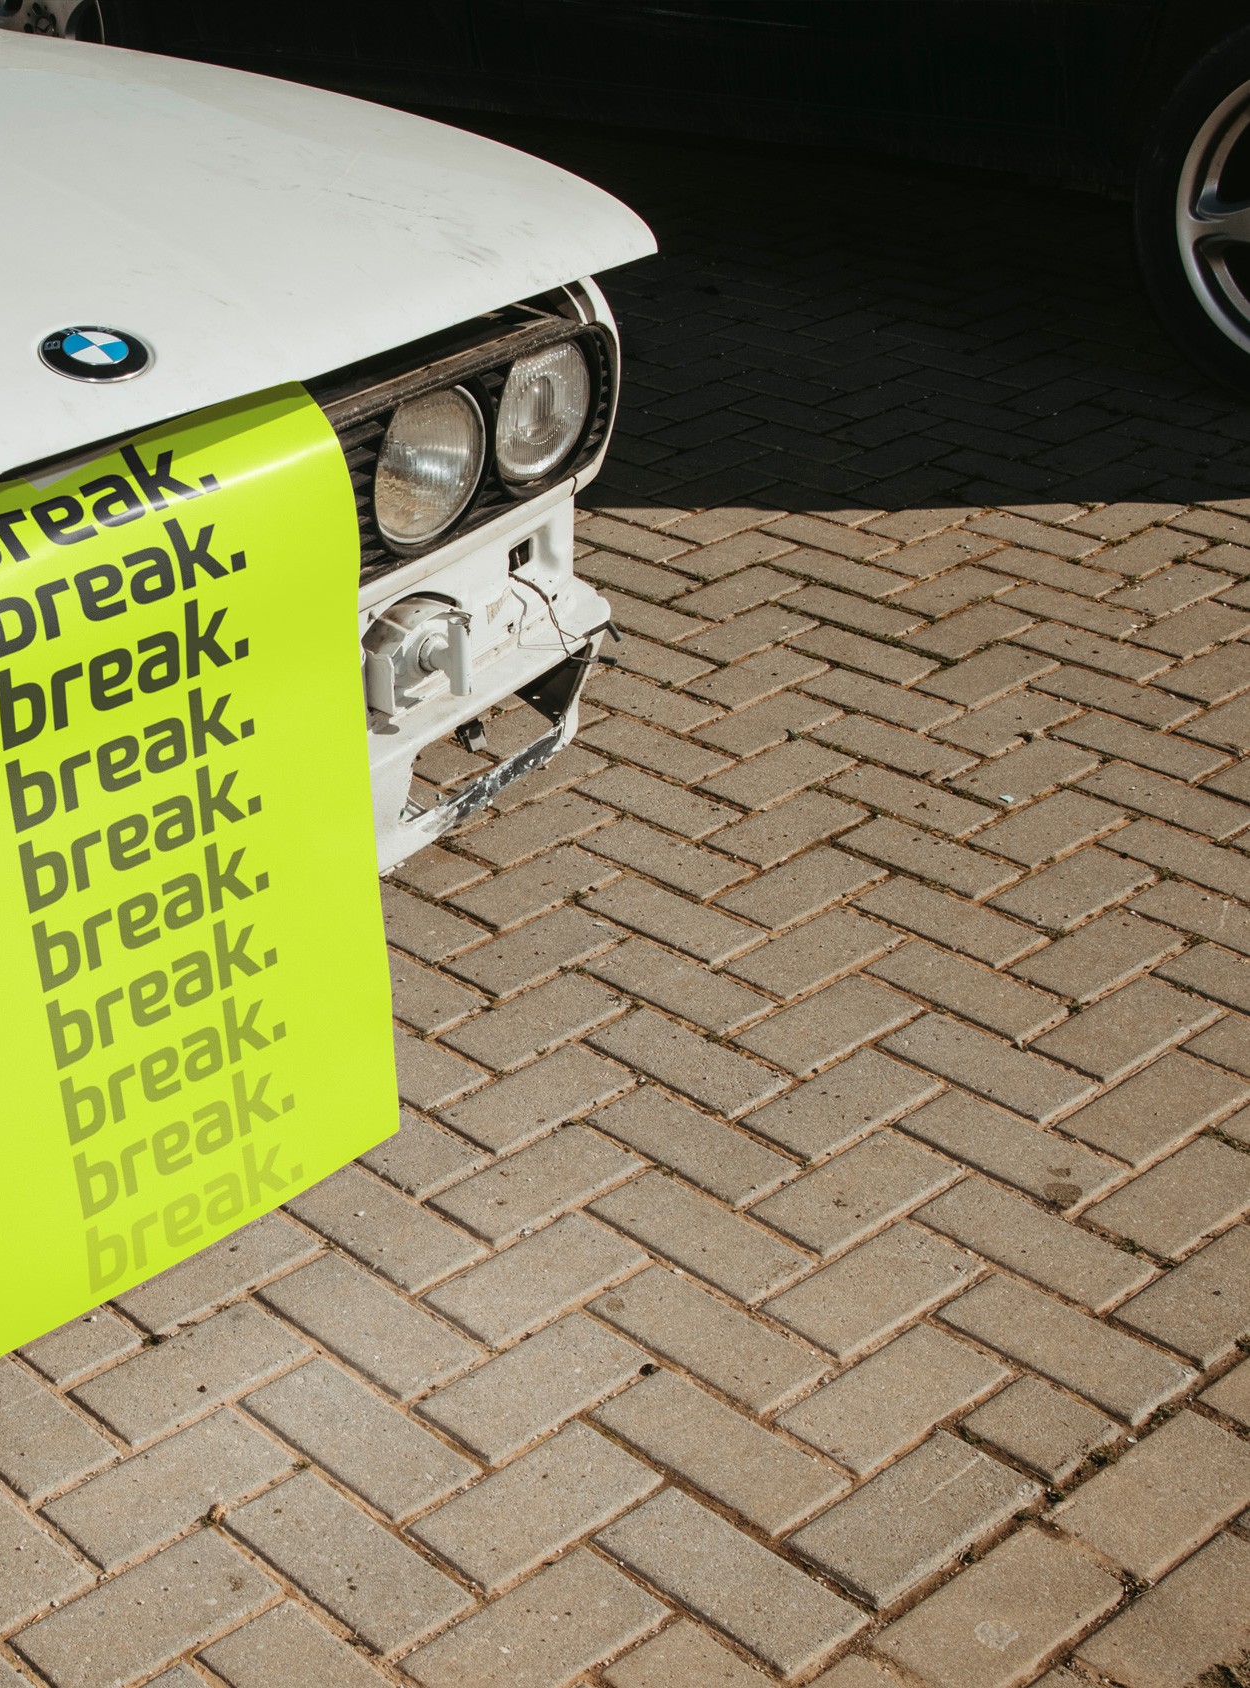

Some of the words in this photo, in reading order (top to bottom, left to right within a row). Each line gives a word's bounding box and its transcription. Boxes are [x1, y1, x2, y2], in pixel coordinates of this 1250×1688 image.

[5, 687, 255, 834] break.
[18, 764, 262, 914] break.
[31, 842, 269, 993] break.
[45, 919, 278, 1071] break.
[59, 995, 287, 1146] break.
[73, 1070, 296, 1220] break.
[85, 1142, 304, 1294] break.
